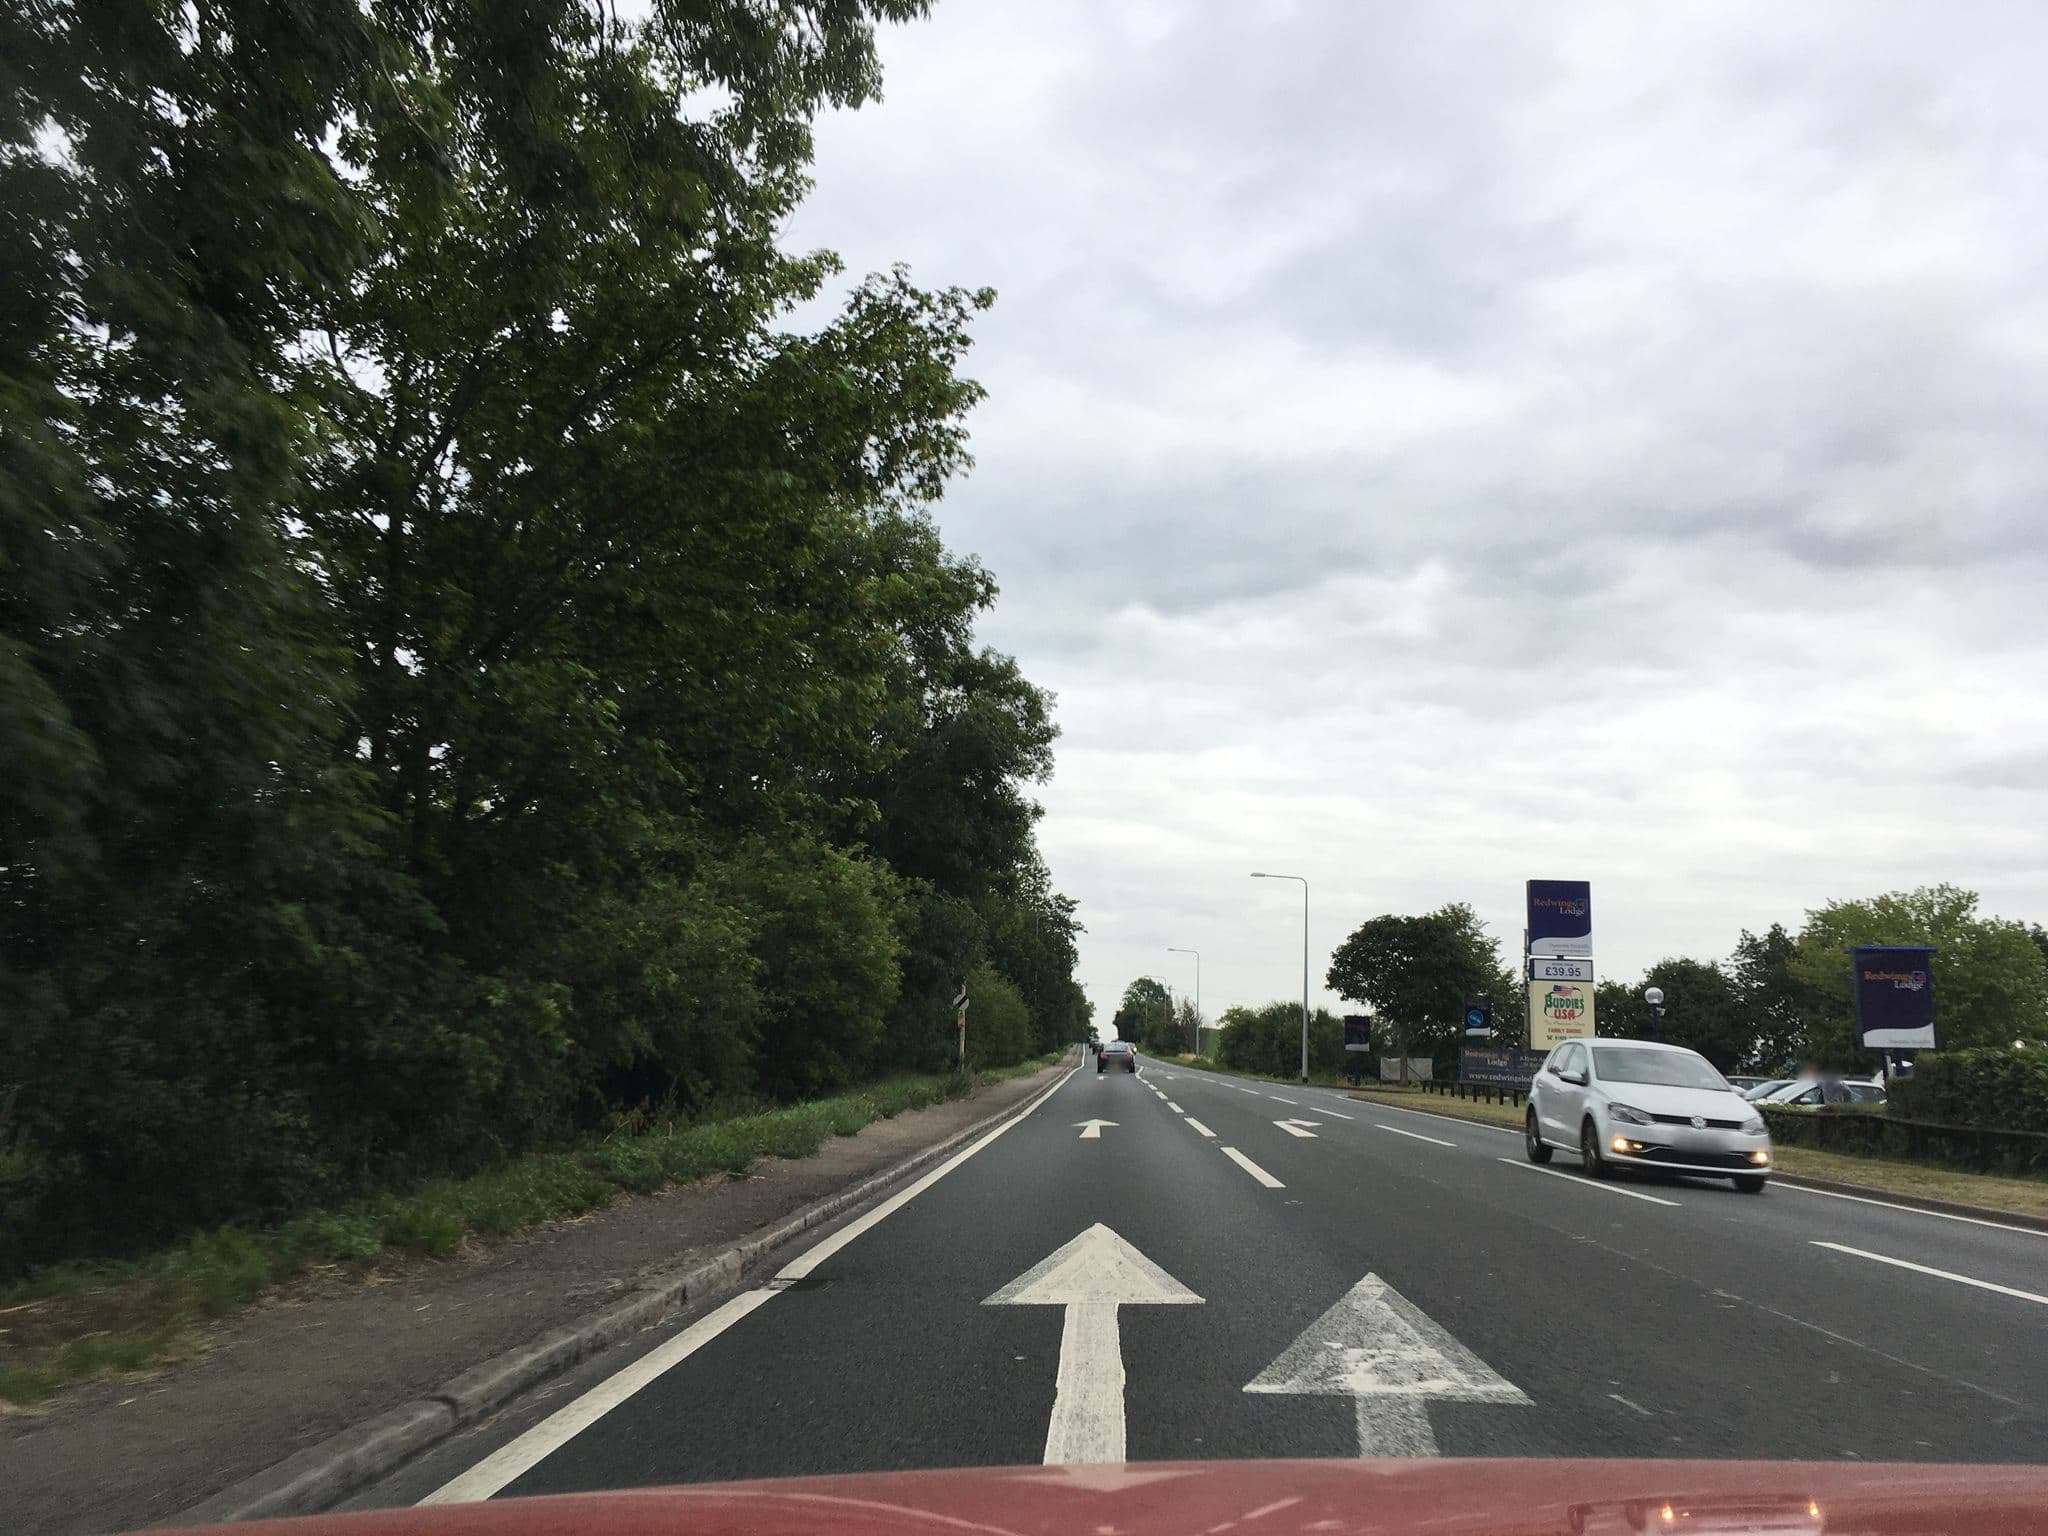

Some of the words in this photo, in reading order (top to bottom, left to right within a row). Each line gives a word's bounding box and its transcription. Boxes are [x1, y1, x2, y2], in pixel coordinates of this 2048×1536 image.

[1534, 898, 1577, 909] Redwings
[1560, 907, 1585, 917] Lodge
[1545, 966, 1581, 977] £39.95
[1894, 980, 1924, 991] Lodge
[1554, 1009, 1575, 1020] USA
[1487, 1058, 1508, 1067] Lodge
